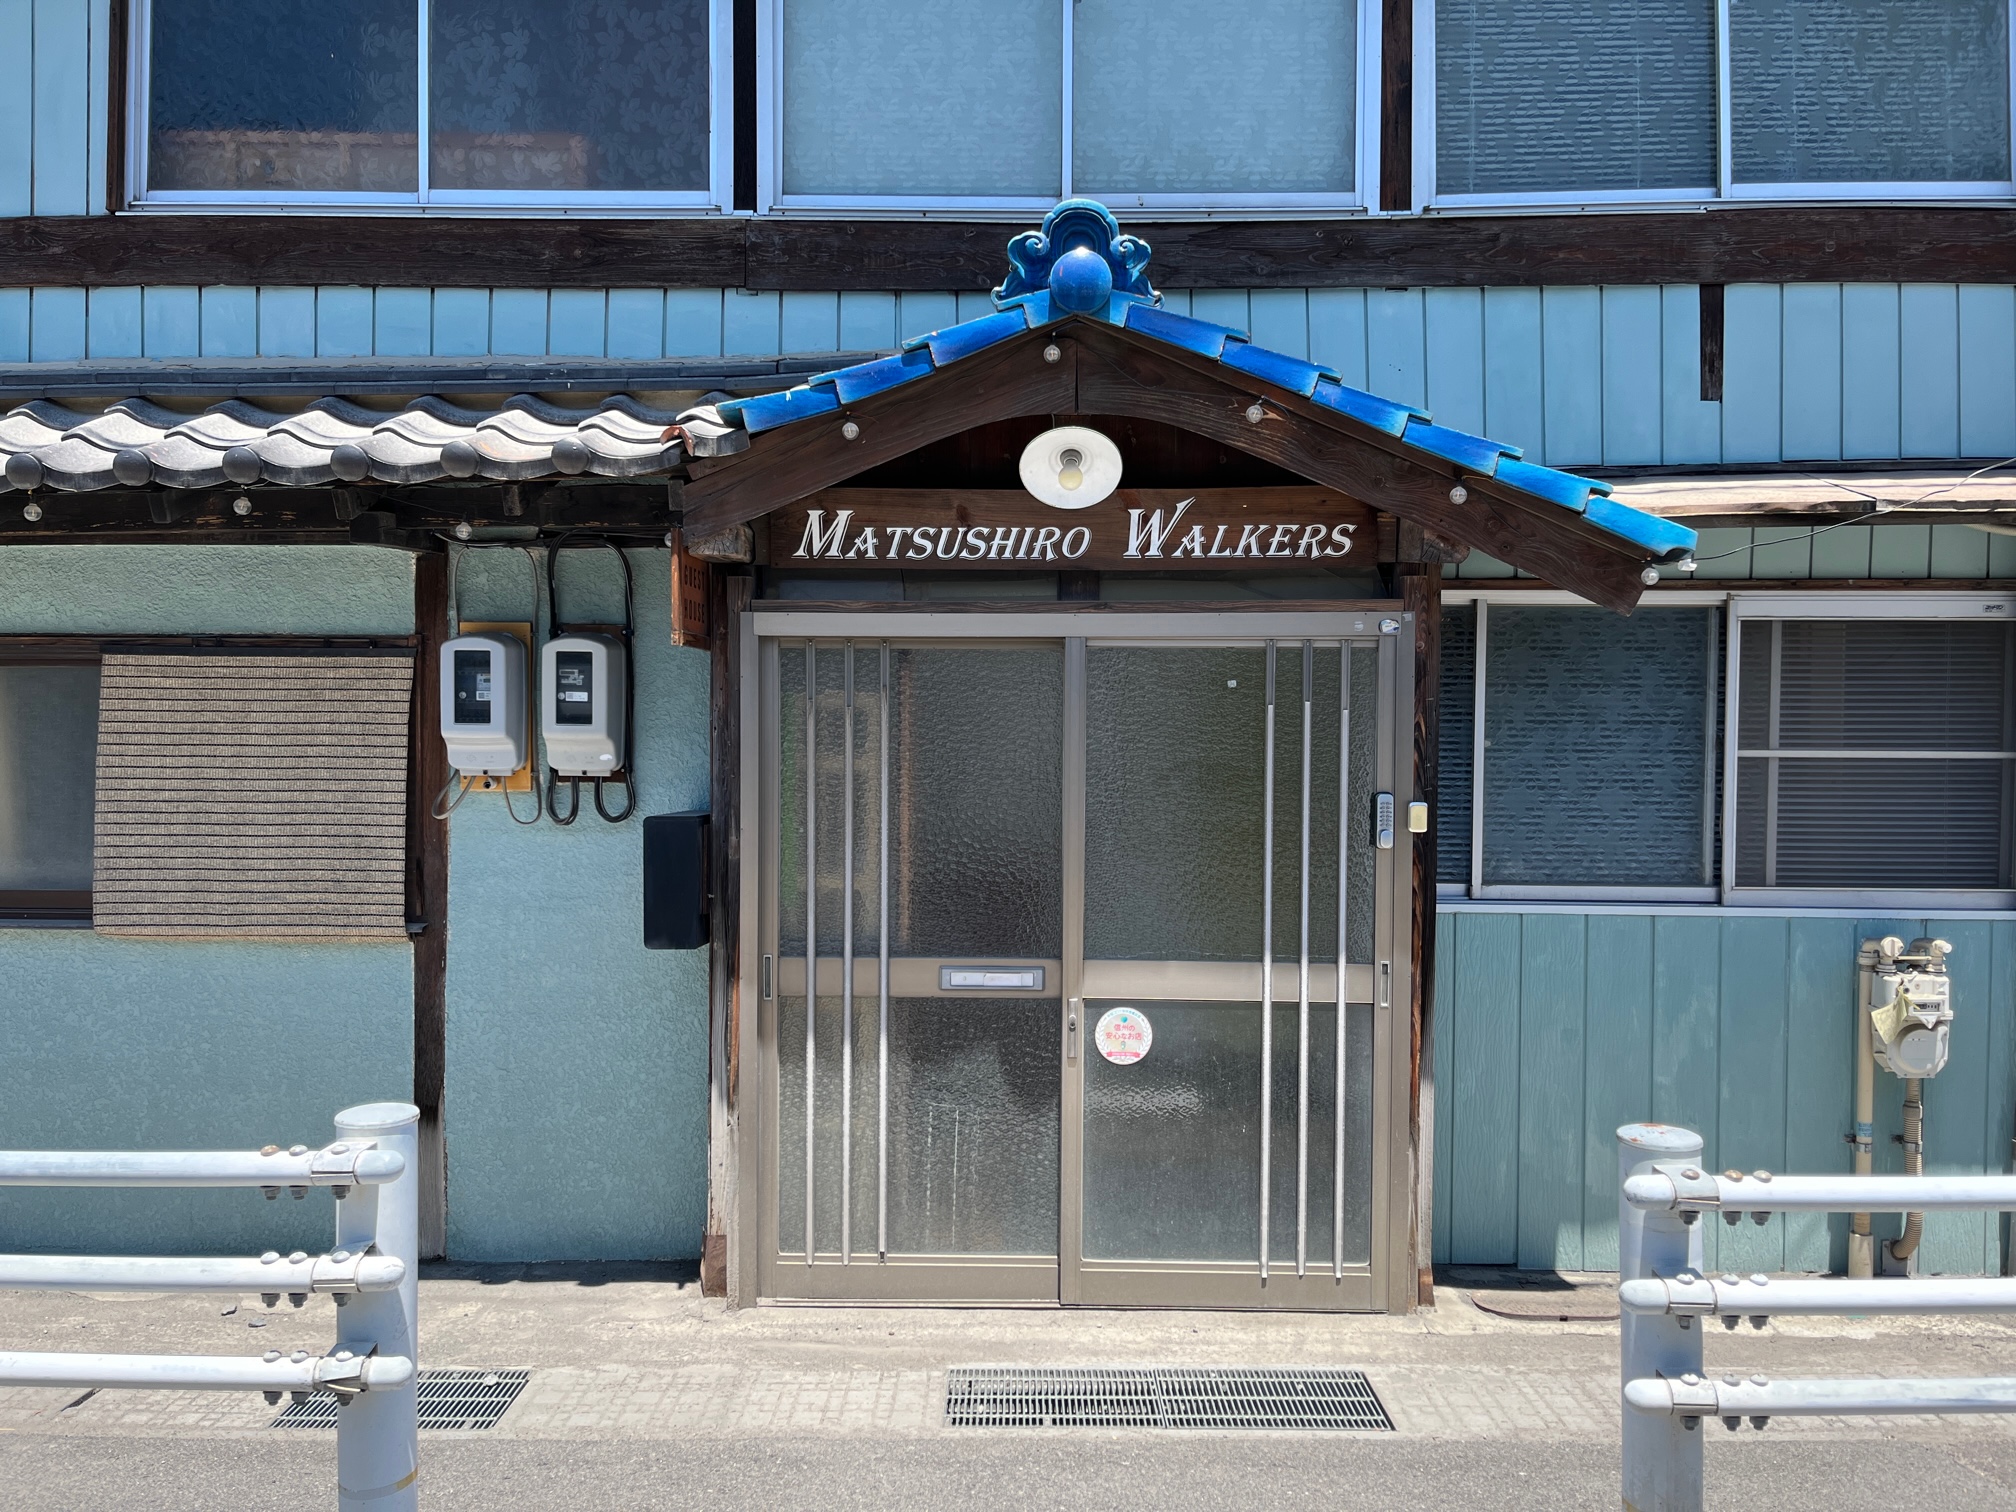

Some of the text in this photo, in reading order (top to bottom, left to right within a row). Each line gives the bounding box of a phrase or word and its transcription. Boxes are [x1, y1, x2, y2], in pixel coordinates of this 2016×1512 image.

[791, 496, 1358, 562] MATSUSHIRO WALKERS
[684, 564, 705, 592] GUEST
[684, 598, 705, 624] HOUSE
[1105, 1031, 1143, 1041] 安心なお店
[1113, 1023, 1136, 1032] 信州の
